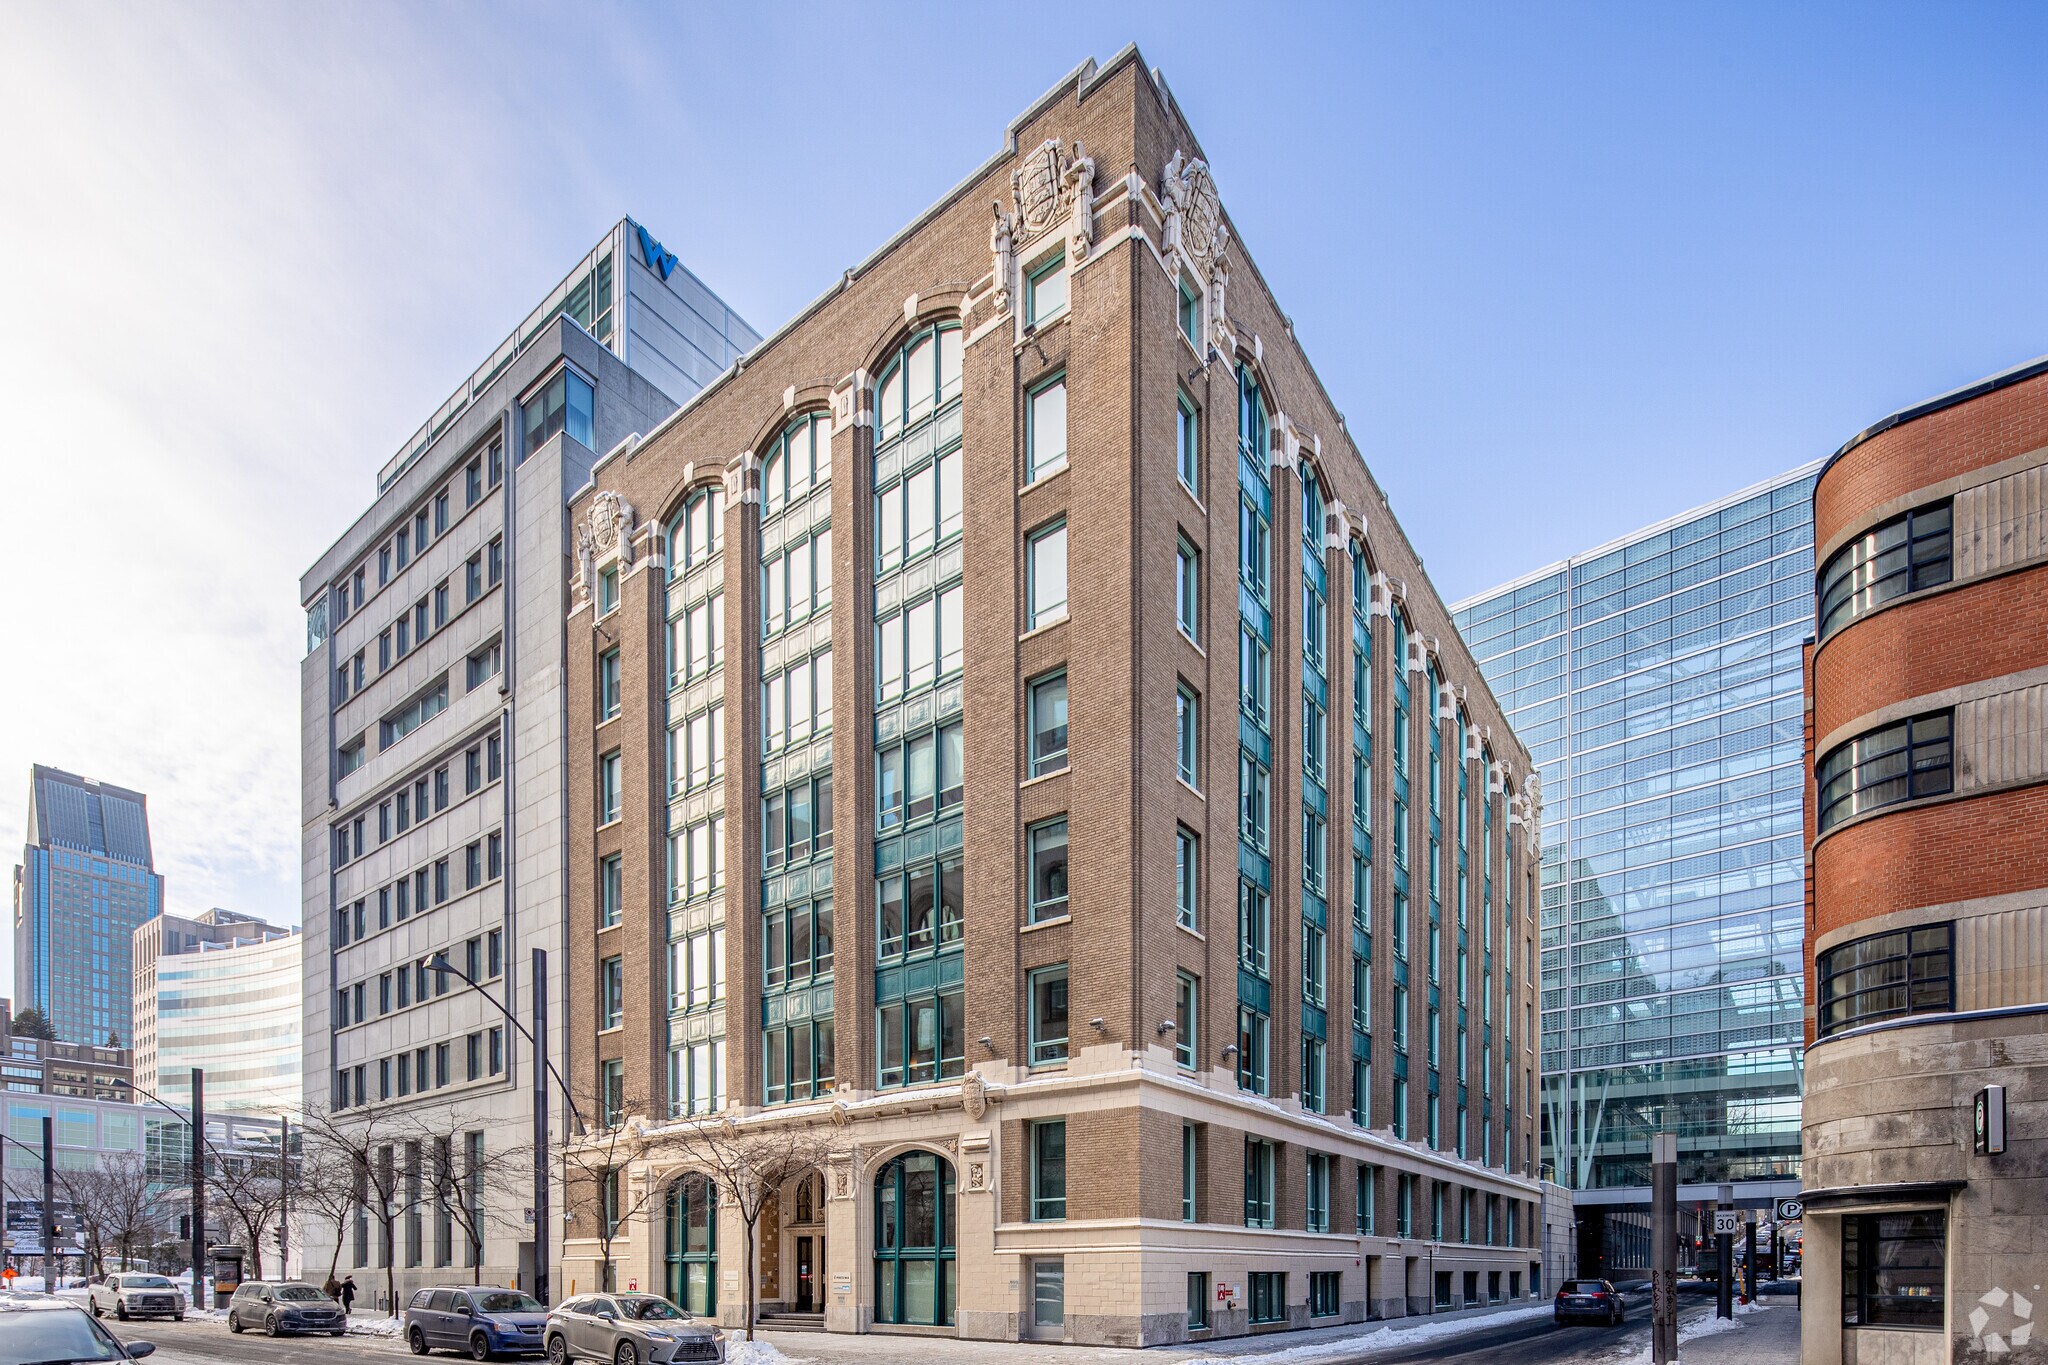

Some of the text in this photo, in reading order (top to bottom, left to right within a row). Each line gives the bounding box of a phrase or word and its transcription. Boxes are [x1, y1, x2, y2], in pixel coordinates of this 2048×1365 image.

[638, 225, 679, 282] W
[1787, 1204, 1797, 1215] P
[1717, 1218, 1734, 1231] 30
